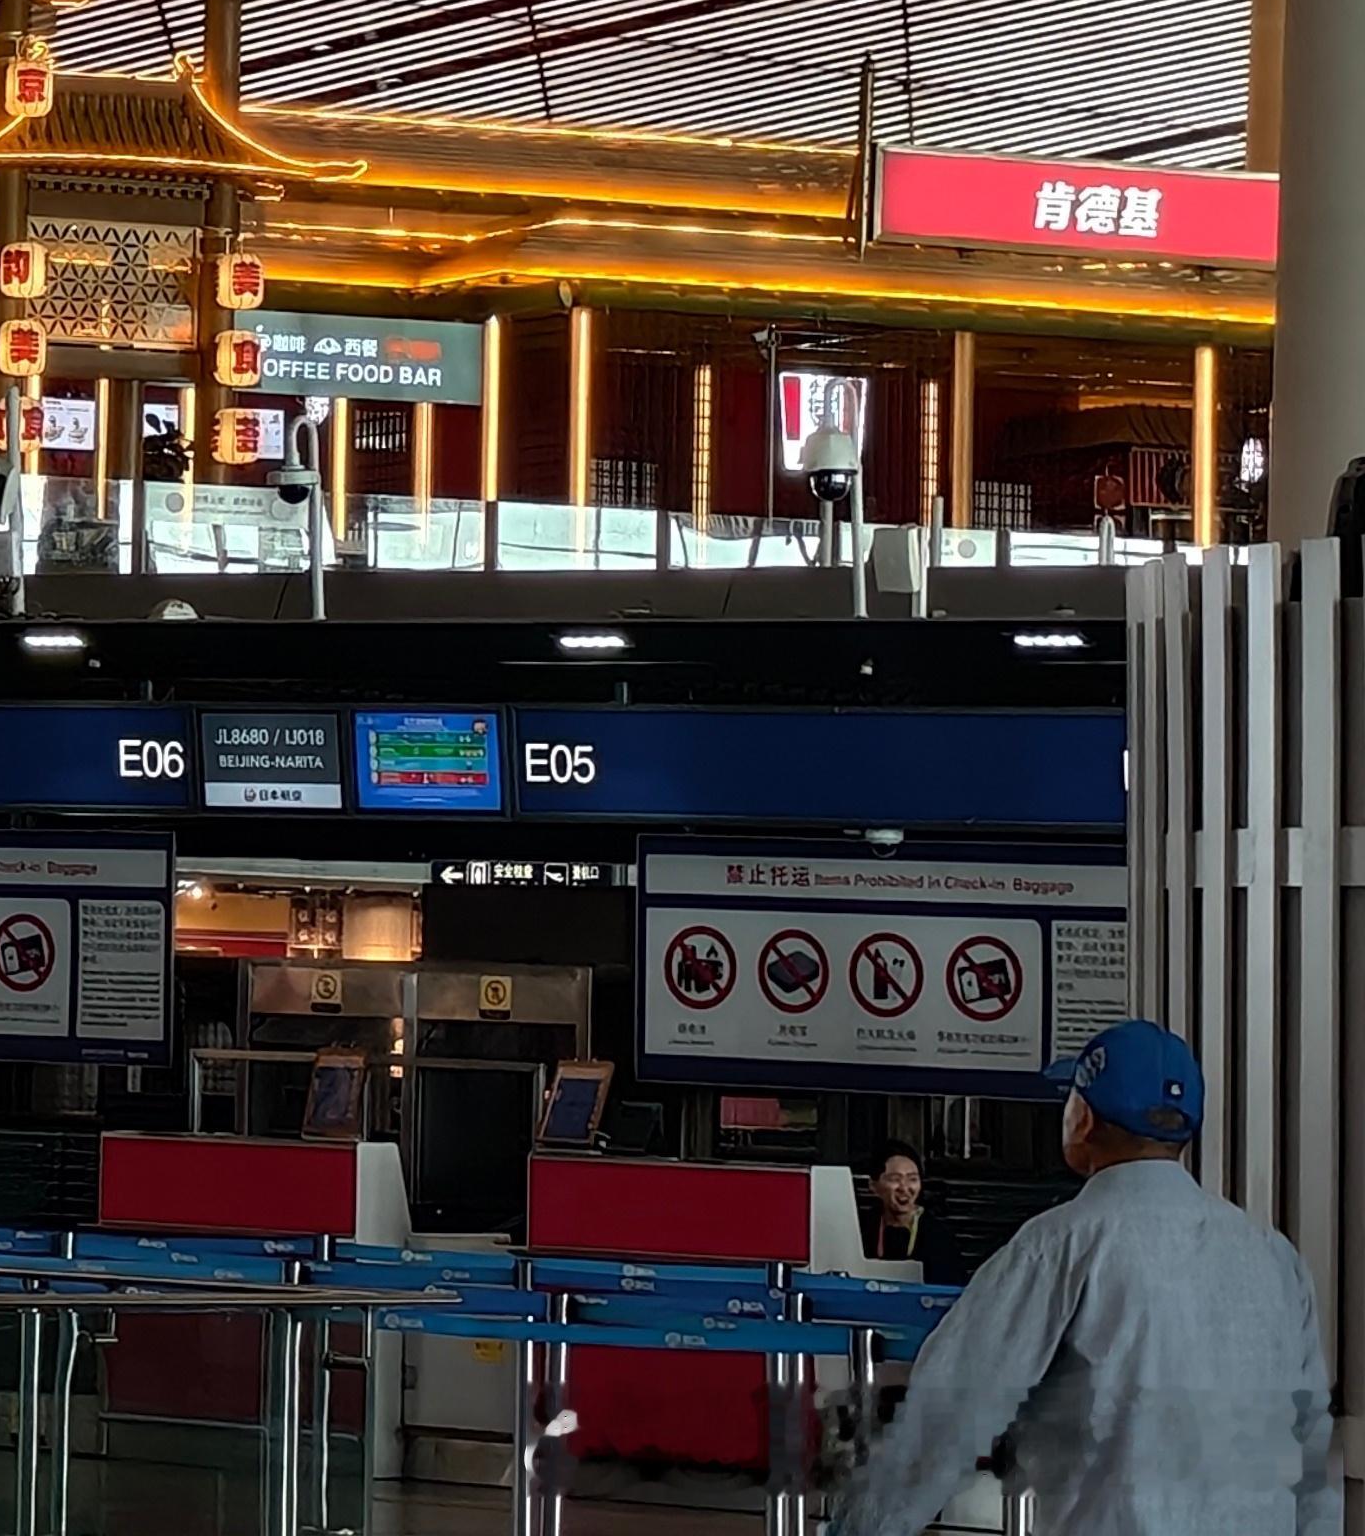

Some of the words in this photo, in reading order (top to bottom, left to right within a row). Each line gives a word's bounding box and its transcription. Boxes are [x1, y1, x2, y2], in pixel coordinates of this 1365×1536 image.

[17, 68, 46, 104] 京
[1034, 181, 1163, 238] 肯德基
[272, 333, 306, 355] 咖啡
[344, 337, 378, 358] 西餐
[262, 358, 331, 381] OFFEE
[335, 363, 393, 384] FOOD
[399, 366, 443, 387] BAR
[215, 728, 269, 745] JL8680
[118, 739, 185, 778] E06
[218, 755, 324, 769] BEIJING-NARITA
[525, 743, 596, 784] E05
[726, 864, 812, 888] 禁止托运
